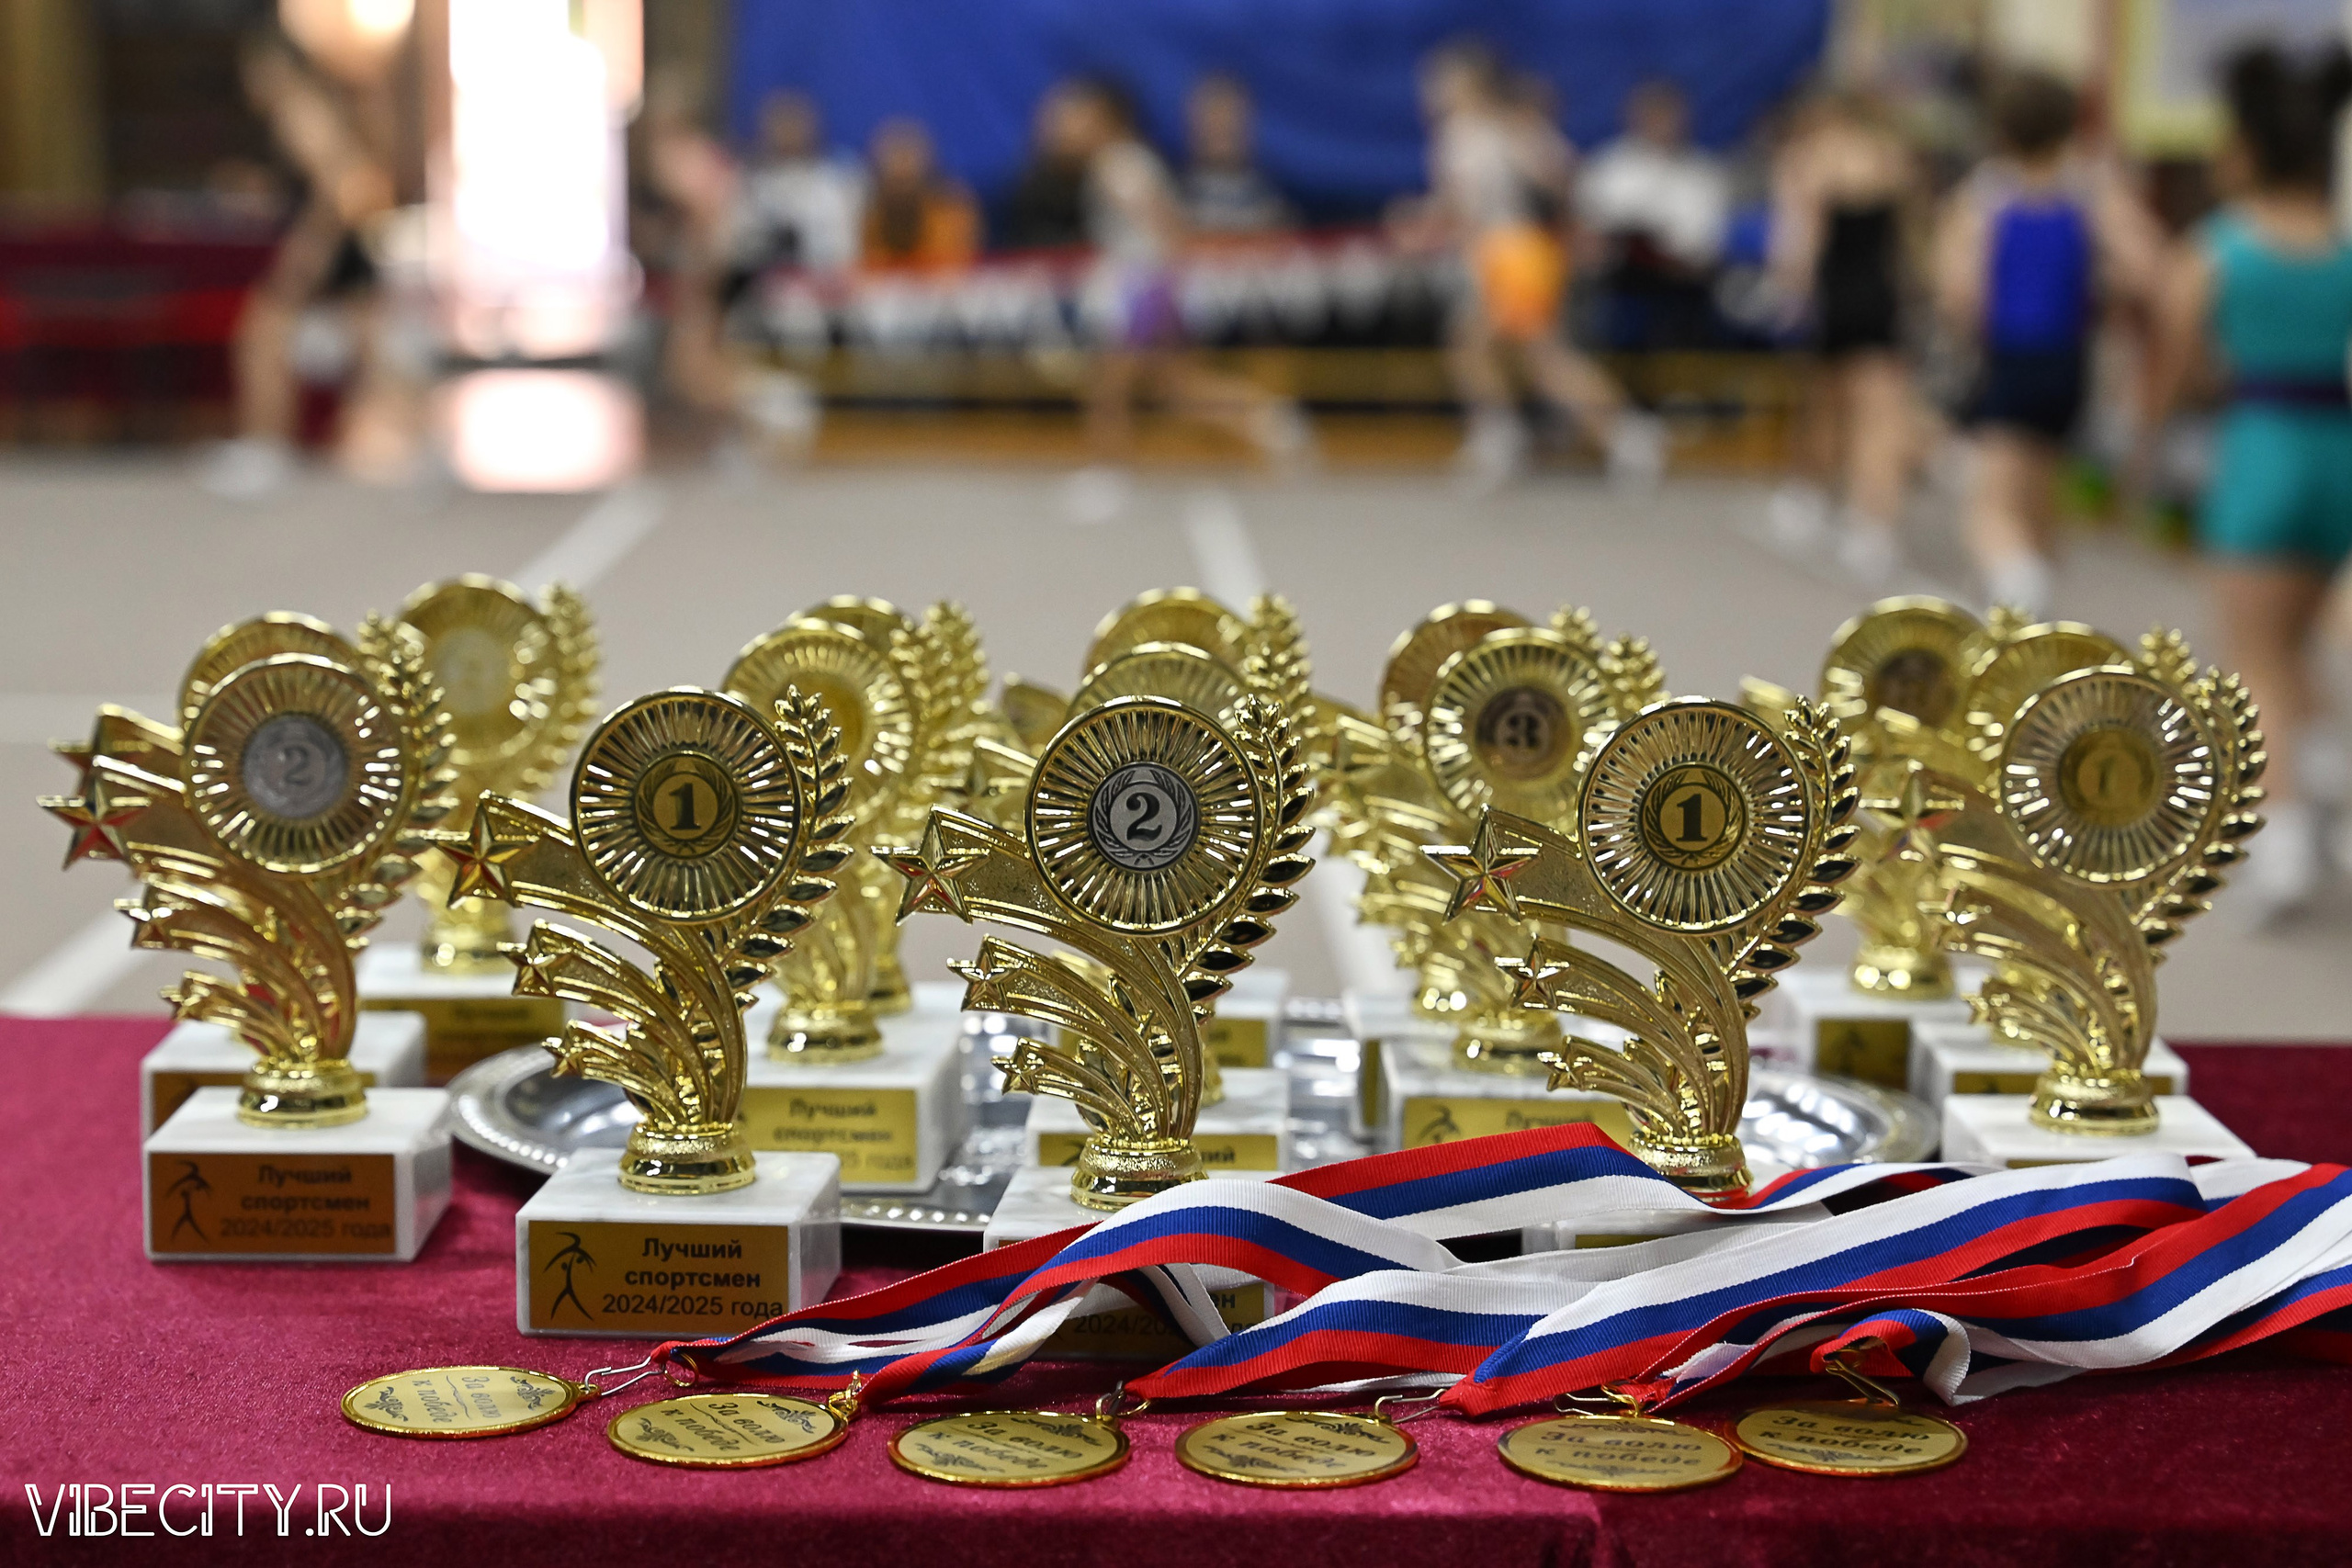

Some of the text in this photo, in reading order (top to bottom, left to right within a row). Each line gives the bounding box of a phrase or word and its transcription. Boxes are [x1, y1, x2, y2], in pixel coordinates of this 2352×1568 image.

[283, 745, 313, 786] 2
[668, 782, 702, 830] 1
[1125, 792, 1163, 840] 2
[1675, 793, 1708, 842] 1
[258, 1164, 352, 1188] Лучший
[240, 1194, 370, 1213] спортсмен
[220, 1218, 391, 1240] 2024/2025 года
[642, 1237, 742, 1262] Лучший
[625, 1269, 761, 1291] спортсмен
[603, 1293, 784, 1319] 2024/2025 года
[411, 1379, 458, 1423] к победе
[462, 1376, 502, 1419] За волю
[661, 1408, 684, 1416] к
[708, 1402, 786, 1444] За волю
[1772, 1416, 1817, 1428] За
[1541, 1431, 1585, 1443] За
[1535, 1447, 1556, 1455] к
